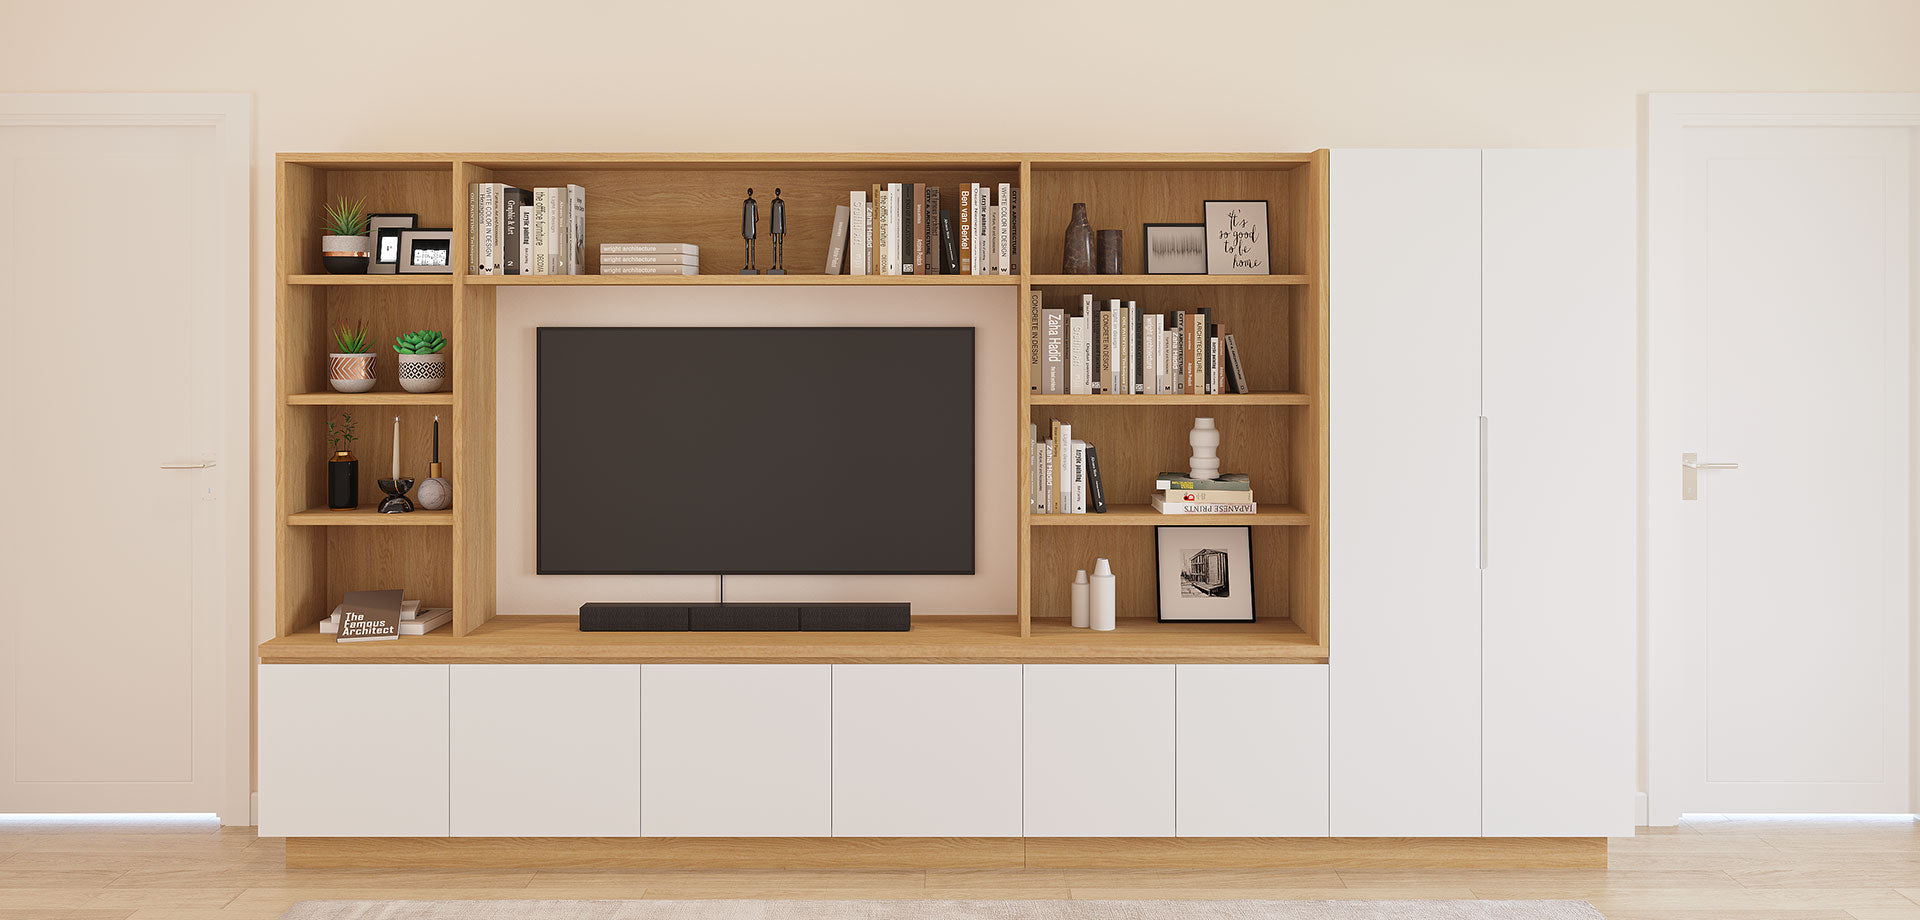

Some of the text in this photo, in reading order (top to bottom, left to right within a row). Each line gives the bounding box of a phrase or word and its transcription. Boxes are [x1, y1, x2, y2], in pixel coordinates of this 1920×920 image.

[536, 192, 545, 201] the
[506, 200, 515, 219] Graphic
[962, 191, 970, 249] Ben van Berkel
[506, 226, 515, 235] Art
[536, 221, 545, 246] furniture
[1219, 225, 1259, 246] so good
[1224, 241, 1234, 254] to
[1233, 254, 1262, 268] home
[1049, 314, 1061, 335] Zaha
[1049, 338, 1061, 362] Hadid
[346, 612, 364, 620] The
[342, 626, 394, 636] Architect
[344, 620, 385, 628] Famous
